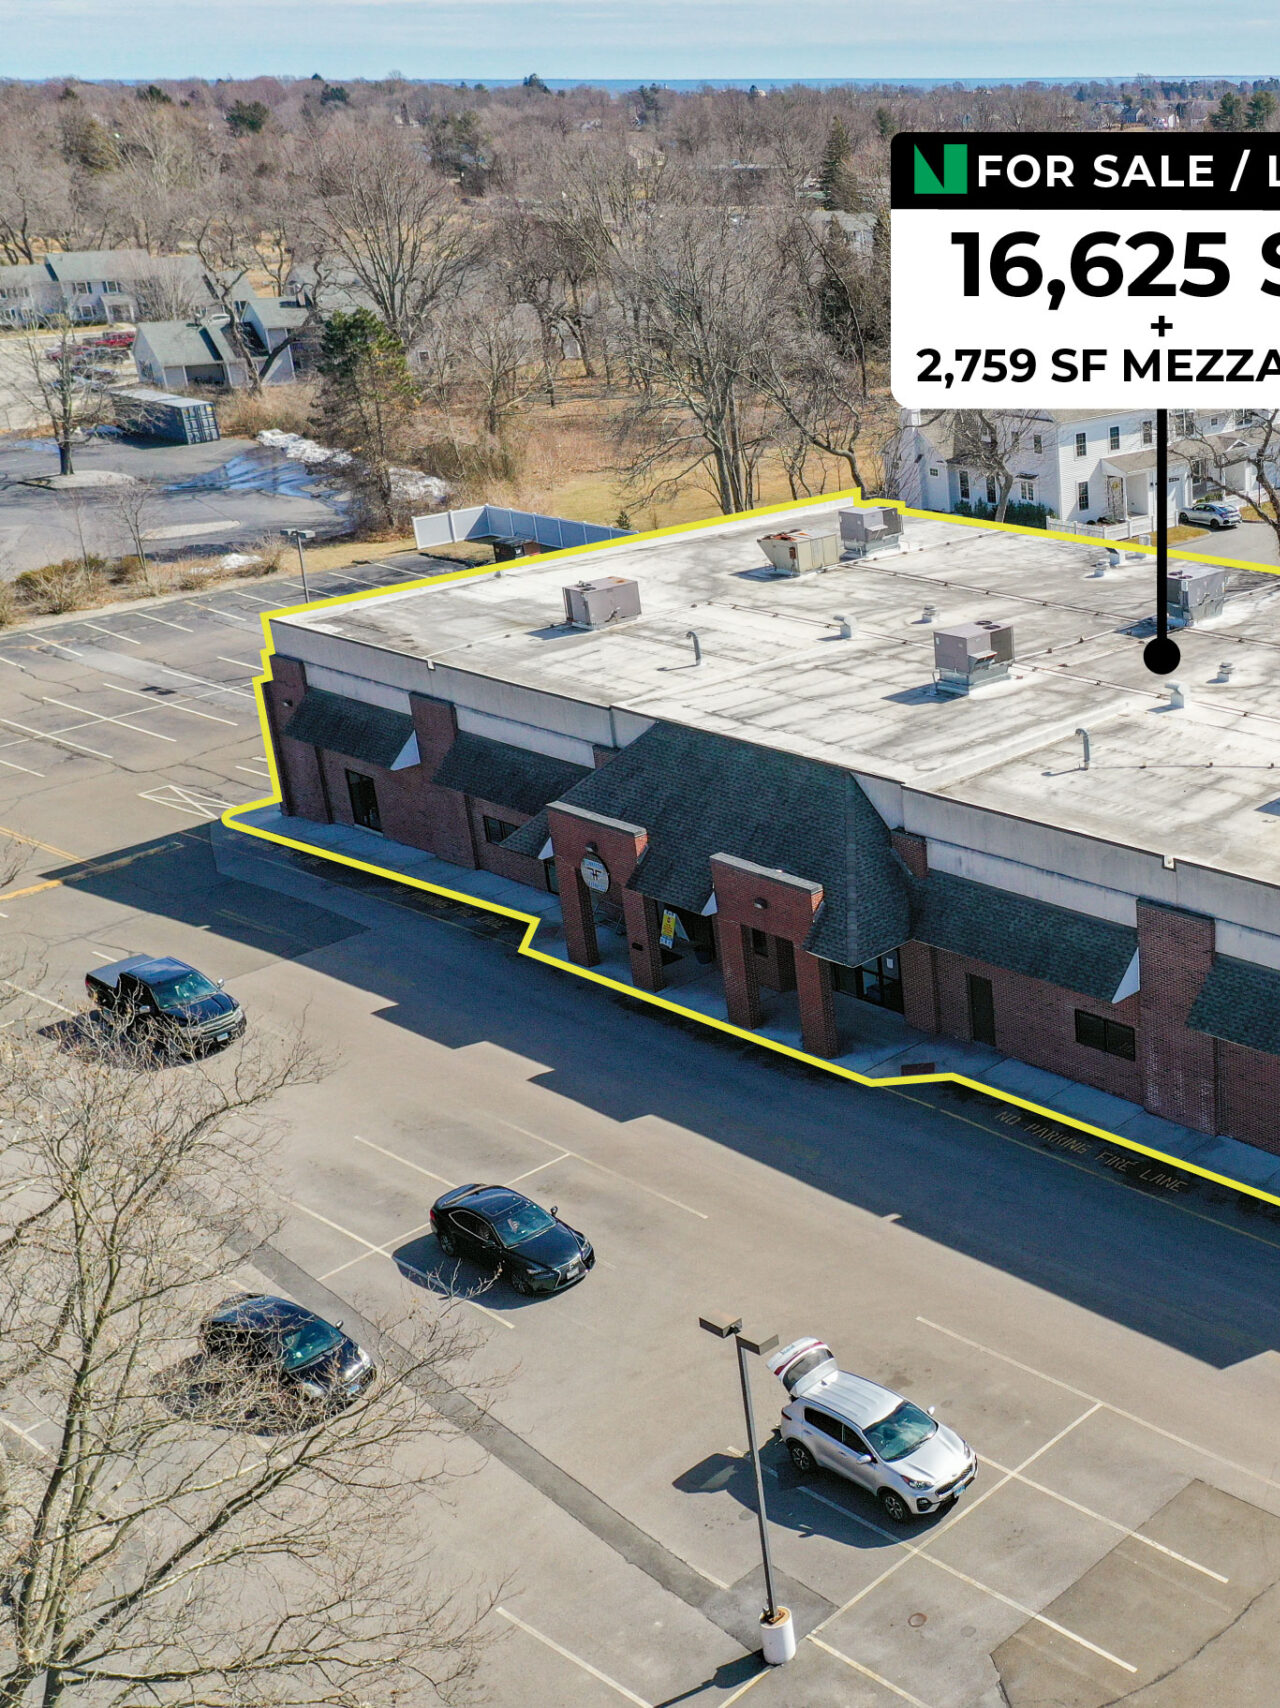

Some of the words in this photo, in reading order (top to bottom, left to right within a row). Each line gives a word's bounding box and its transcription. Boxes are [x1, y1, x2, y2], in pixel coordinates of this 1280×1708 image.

[996, 1111, 1022, 1126] NO
[1025, 1122, 1093, 1153] PARKING
[1095, 1150, 1138, 1172] FIRE
[1139, 1169, 1189, 1192] LANE
